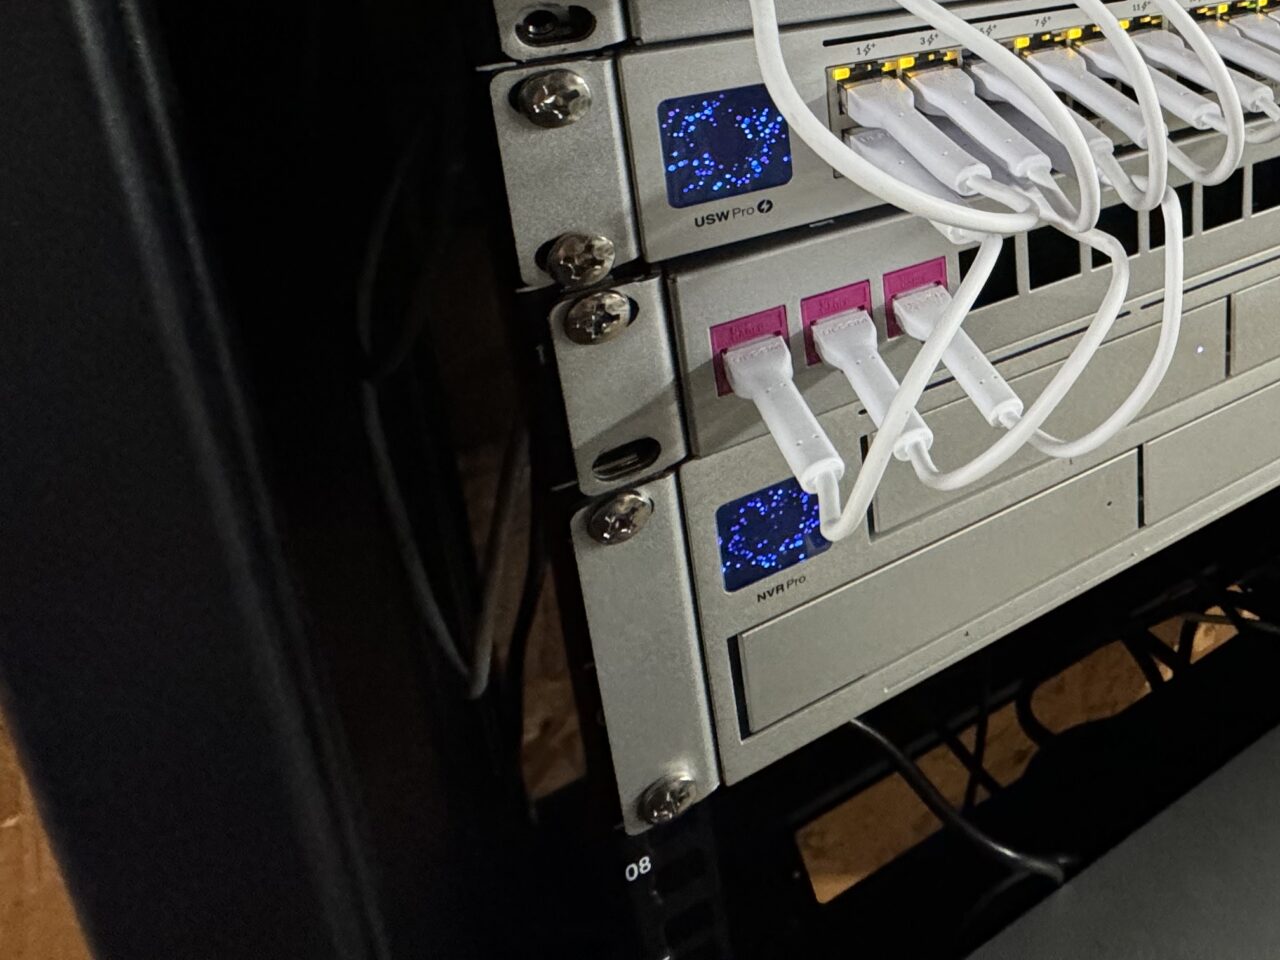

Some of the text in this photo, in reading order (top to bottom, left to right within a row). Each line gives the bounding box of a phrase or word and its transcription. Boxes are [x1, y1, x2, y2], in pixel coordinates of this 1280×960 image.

[694, 206, 755, 228] USW Pro
[756, 575, 807, 603] NVR Pro
[625, 855, 652, 882] 08
